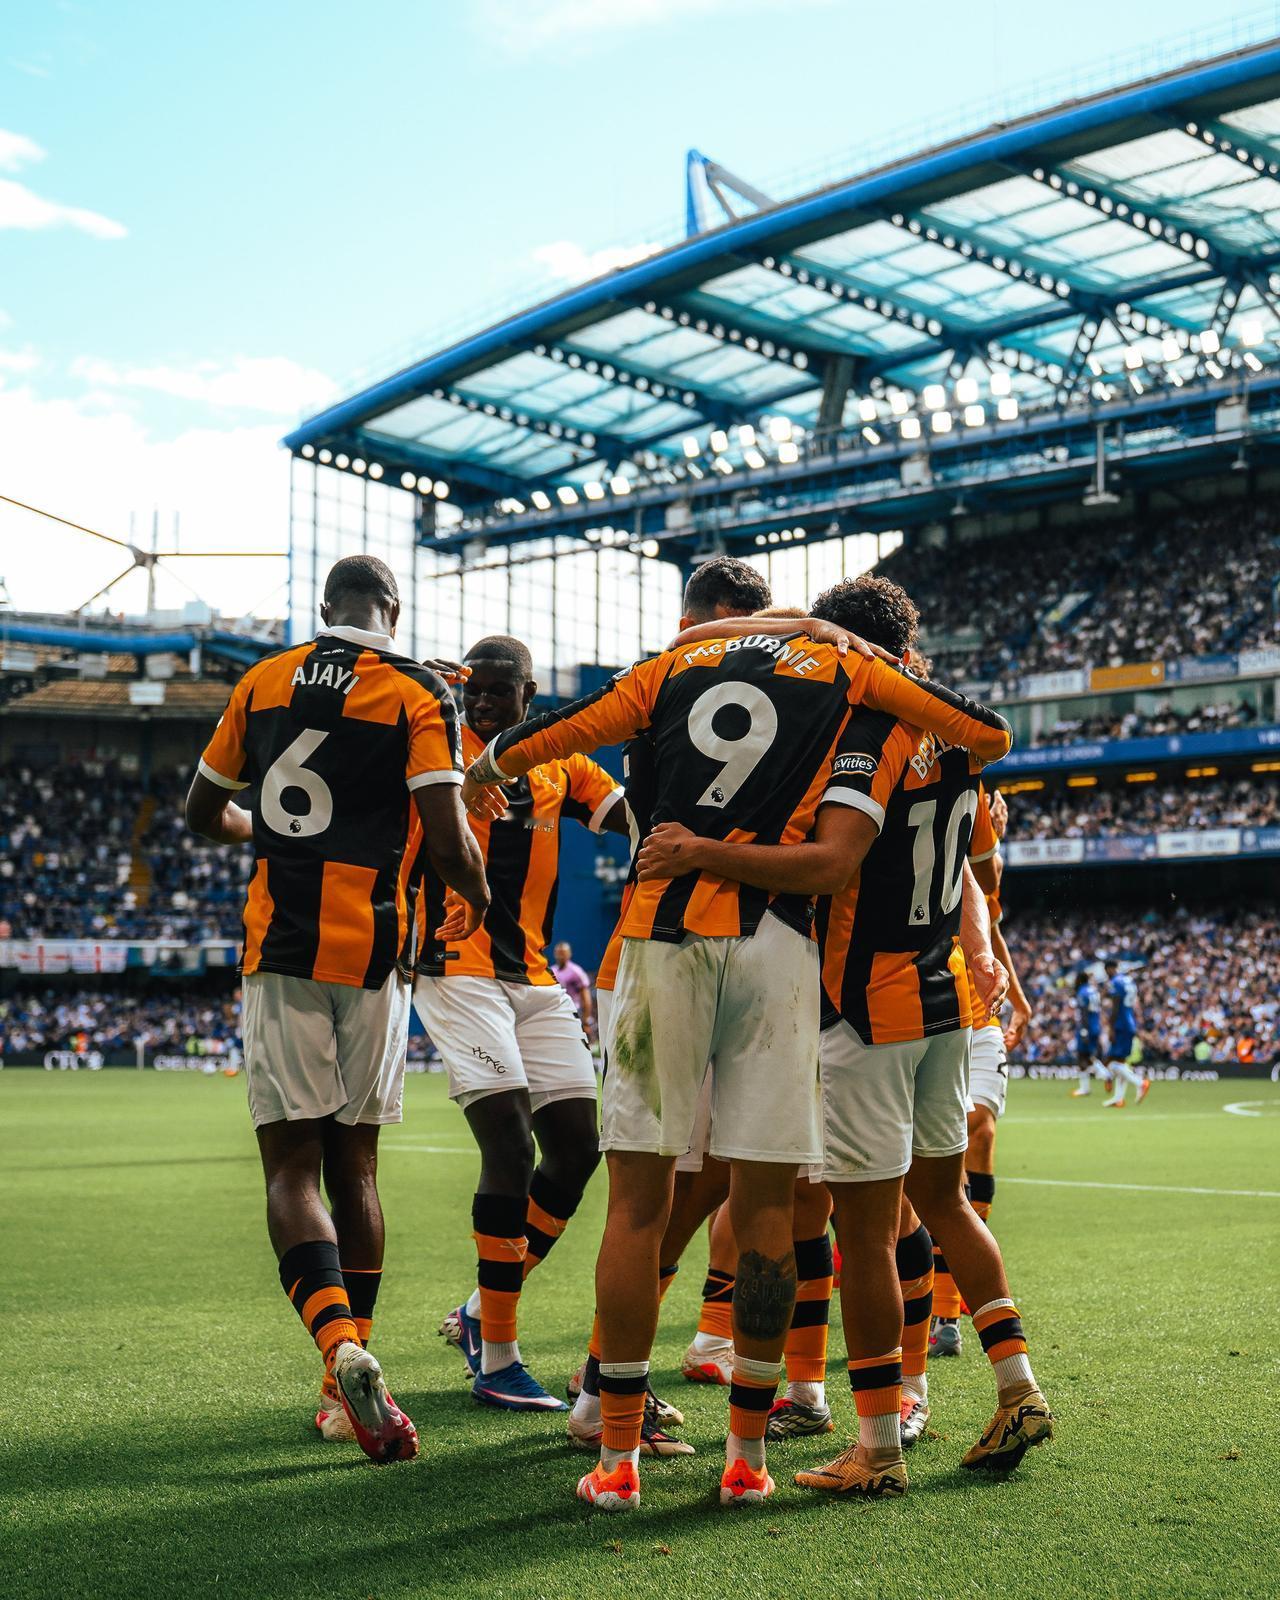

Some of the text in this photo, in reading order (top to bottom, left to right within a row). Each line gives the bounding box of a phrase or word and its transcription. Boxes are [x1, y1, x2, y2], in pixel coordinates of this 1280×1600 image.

[291, 662, 360, 695] AJAYI
[683, 634, 820, 676] McBURNIE
[687, 680, 778, 809] 9
[261, 728, 333, 837] 6
[908, 789, 978, 926] 10
[472, 1046, 506, 1074] HCAFC
